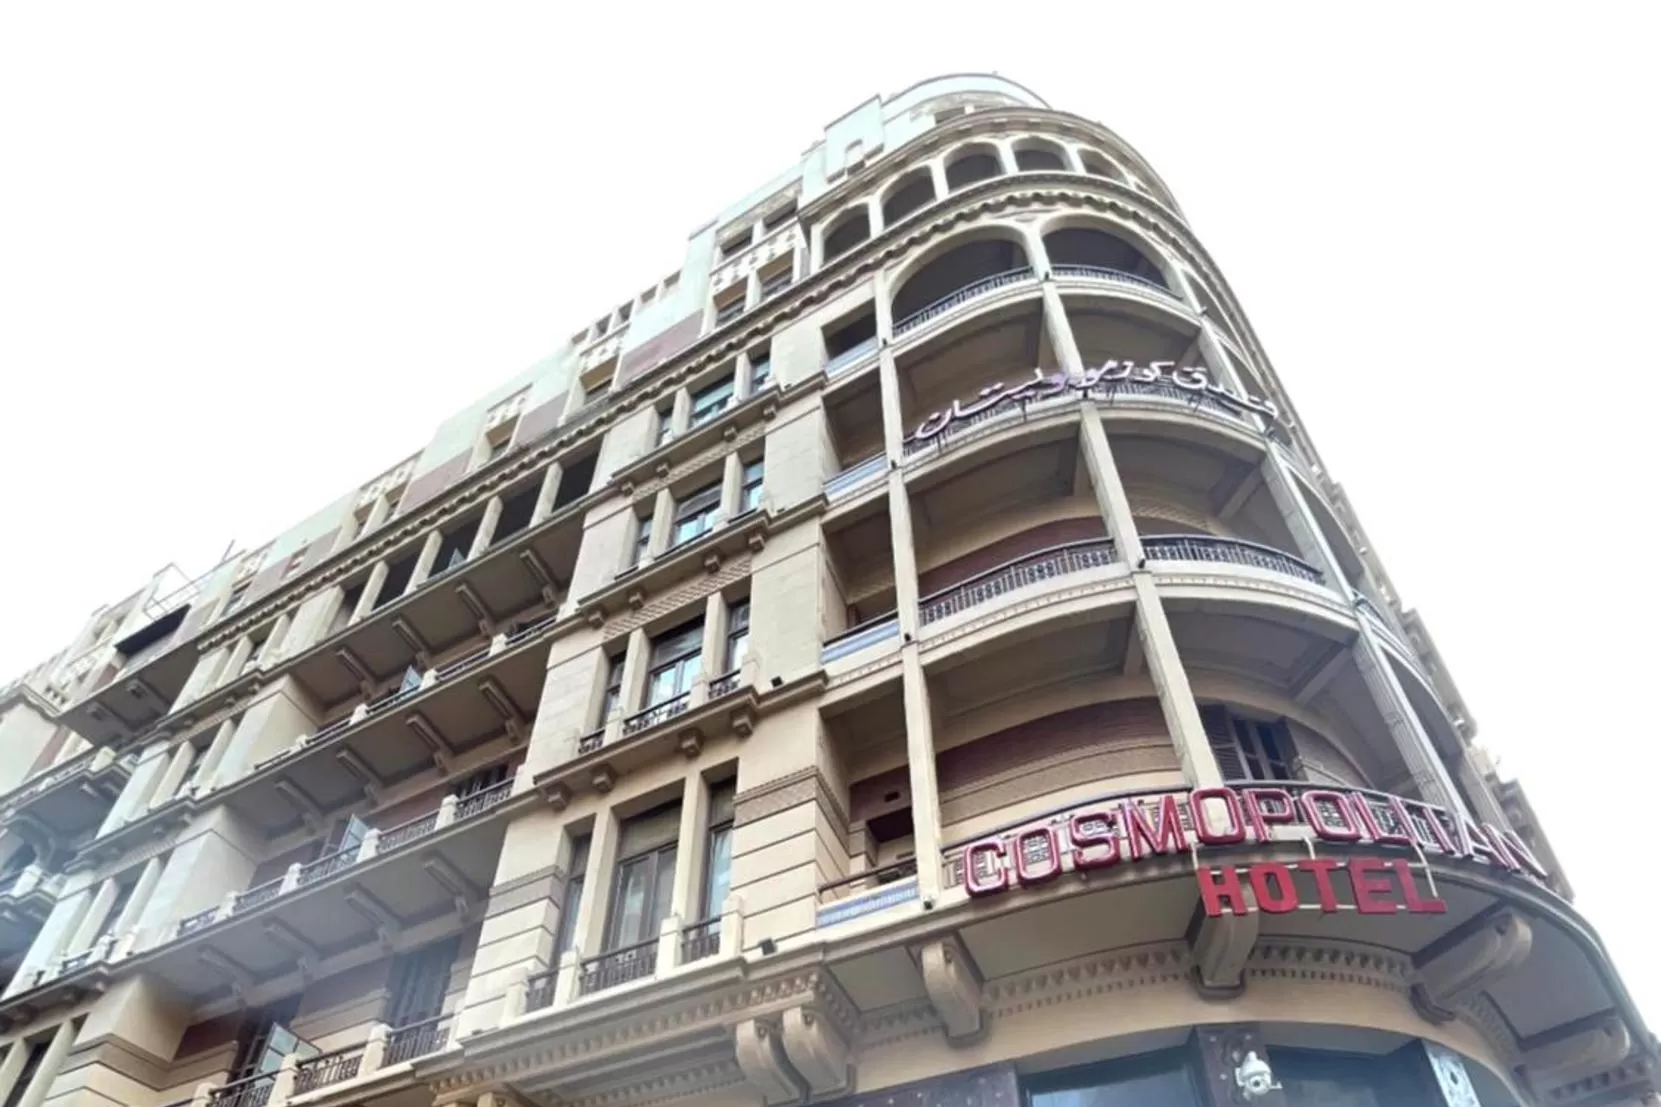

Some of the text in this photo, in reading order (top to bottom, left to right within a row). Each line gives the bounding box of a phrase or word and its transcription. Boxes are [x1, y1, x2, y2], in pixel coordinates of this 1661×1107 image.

[1173, 366, 1279, 419] فندق
[963, 787, 1548, 896] COSMOPOLITAN
[1197, 857, 1447, 917] HOTEL
